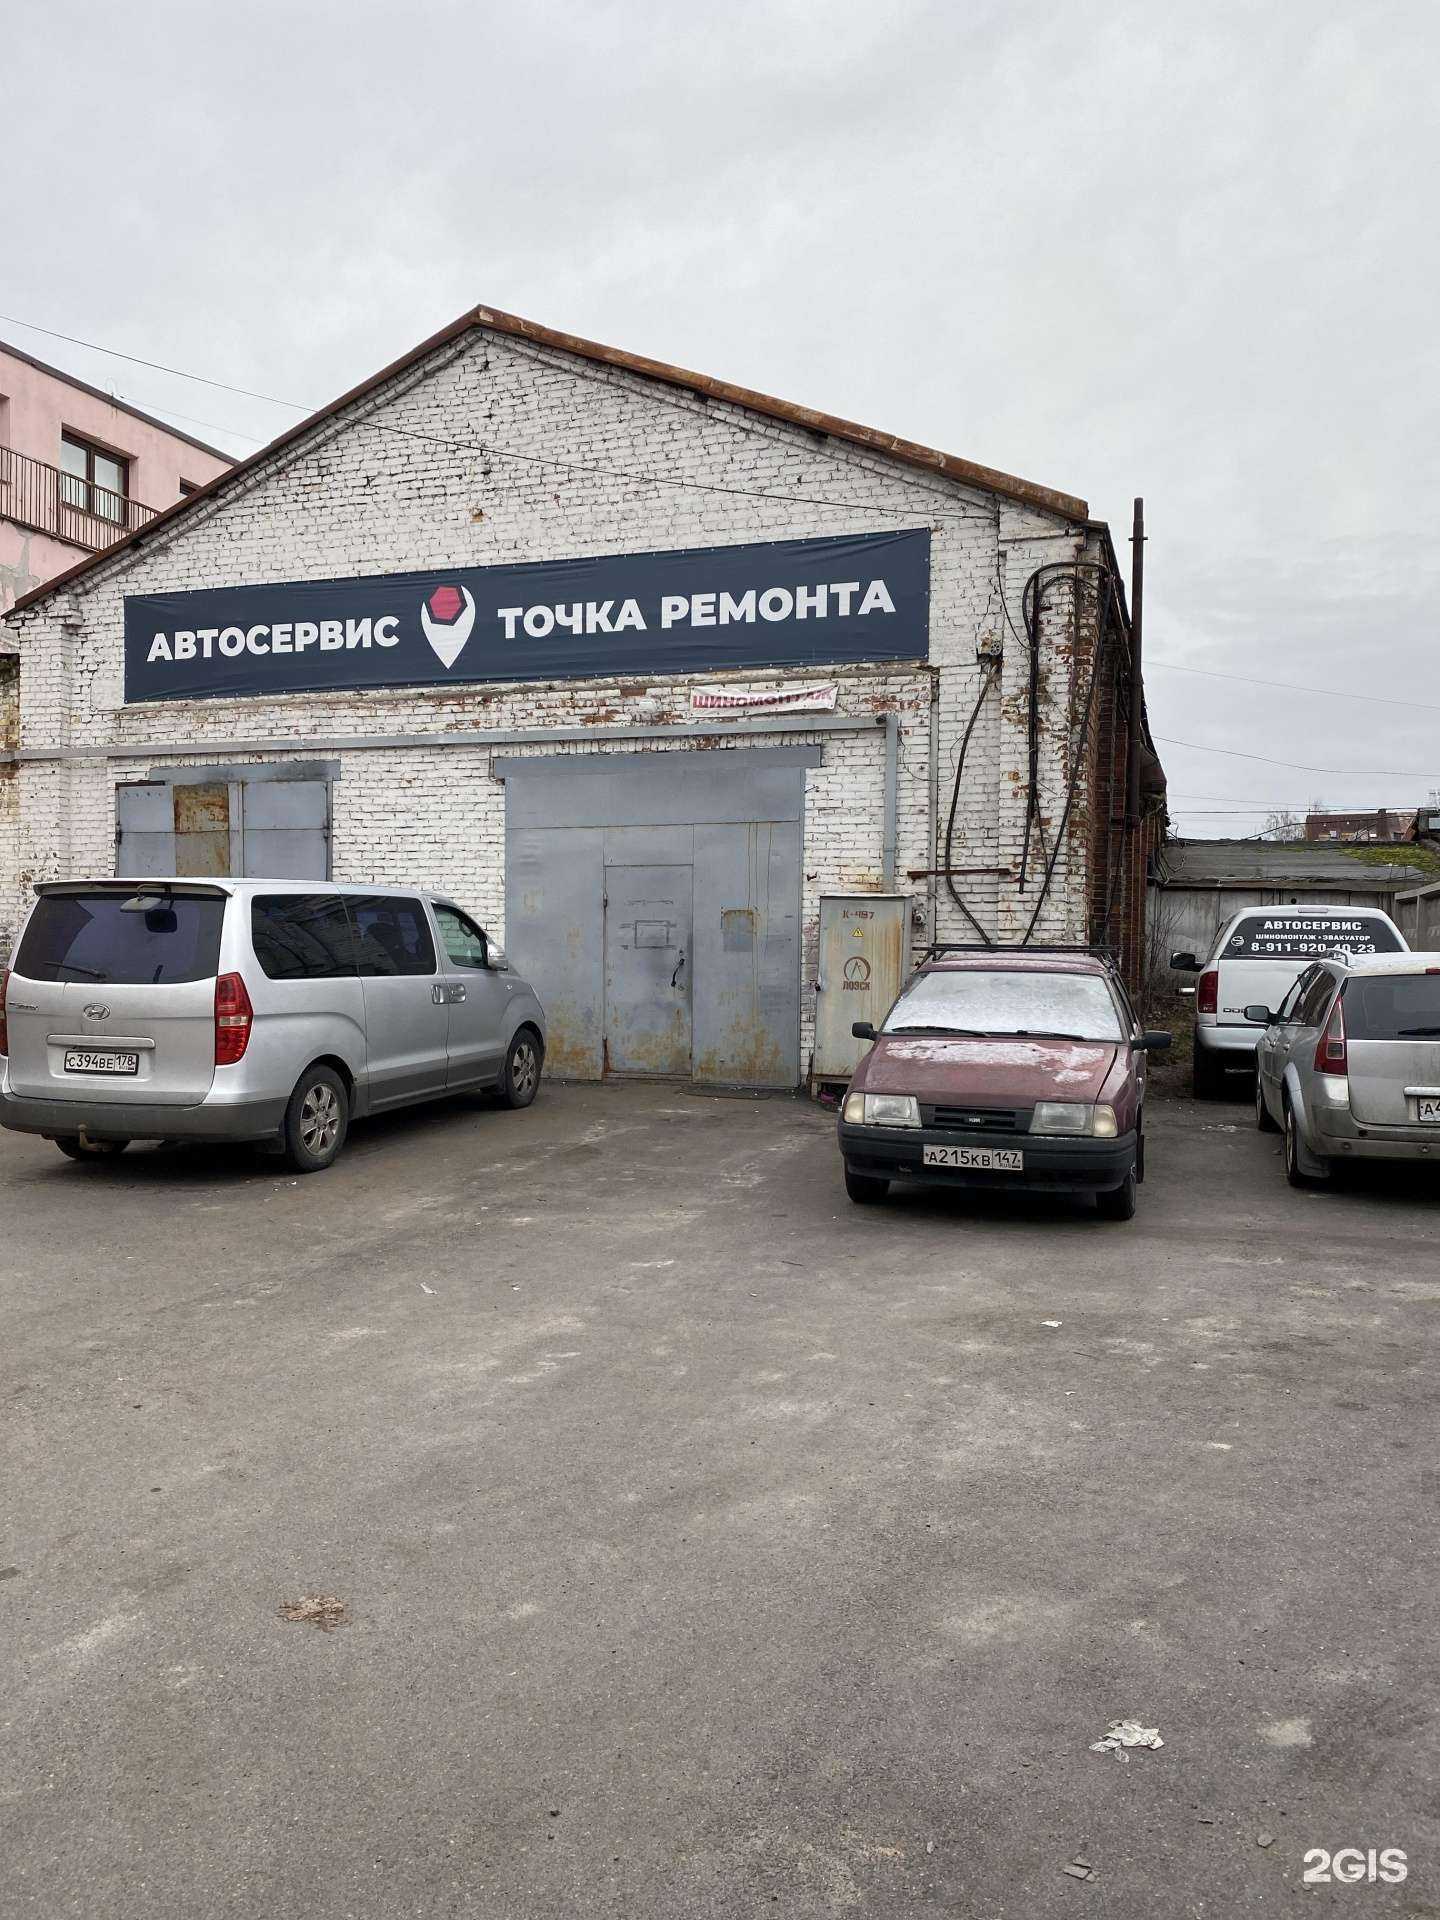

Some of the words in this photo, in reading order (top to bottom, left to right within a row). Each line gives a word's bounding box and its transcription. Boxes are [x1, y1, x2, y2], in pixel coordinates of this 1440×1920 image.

[498, 599, 647, 639] ТОЧКА
[661, 579, 896, 629] РЕМОНТА
[147, 616, 400, 662] АВТОСЕРВИС
[1263, 920, 1362, 931] АВТОСЕРВИС
[69, 1054, 114, 1069] С394ВЕ
[115, 1055, 134, 1066] 178
[928, 1149, 991, 1166] А215КВ
[994, 1152, 1018, 1163] 147
